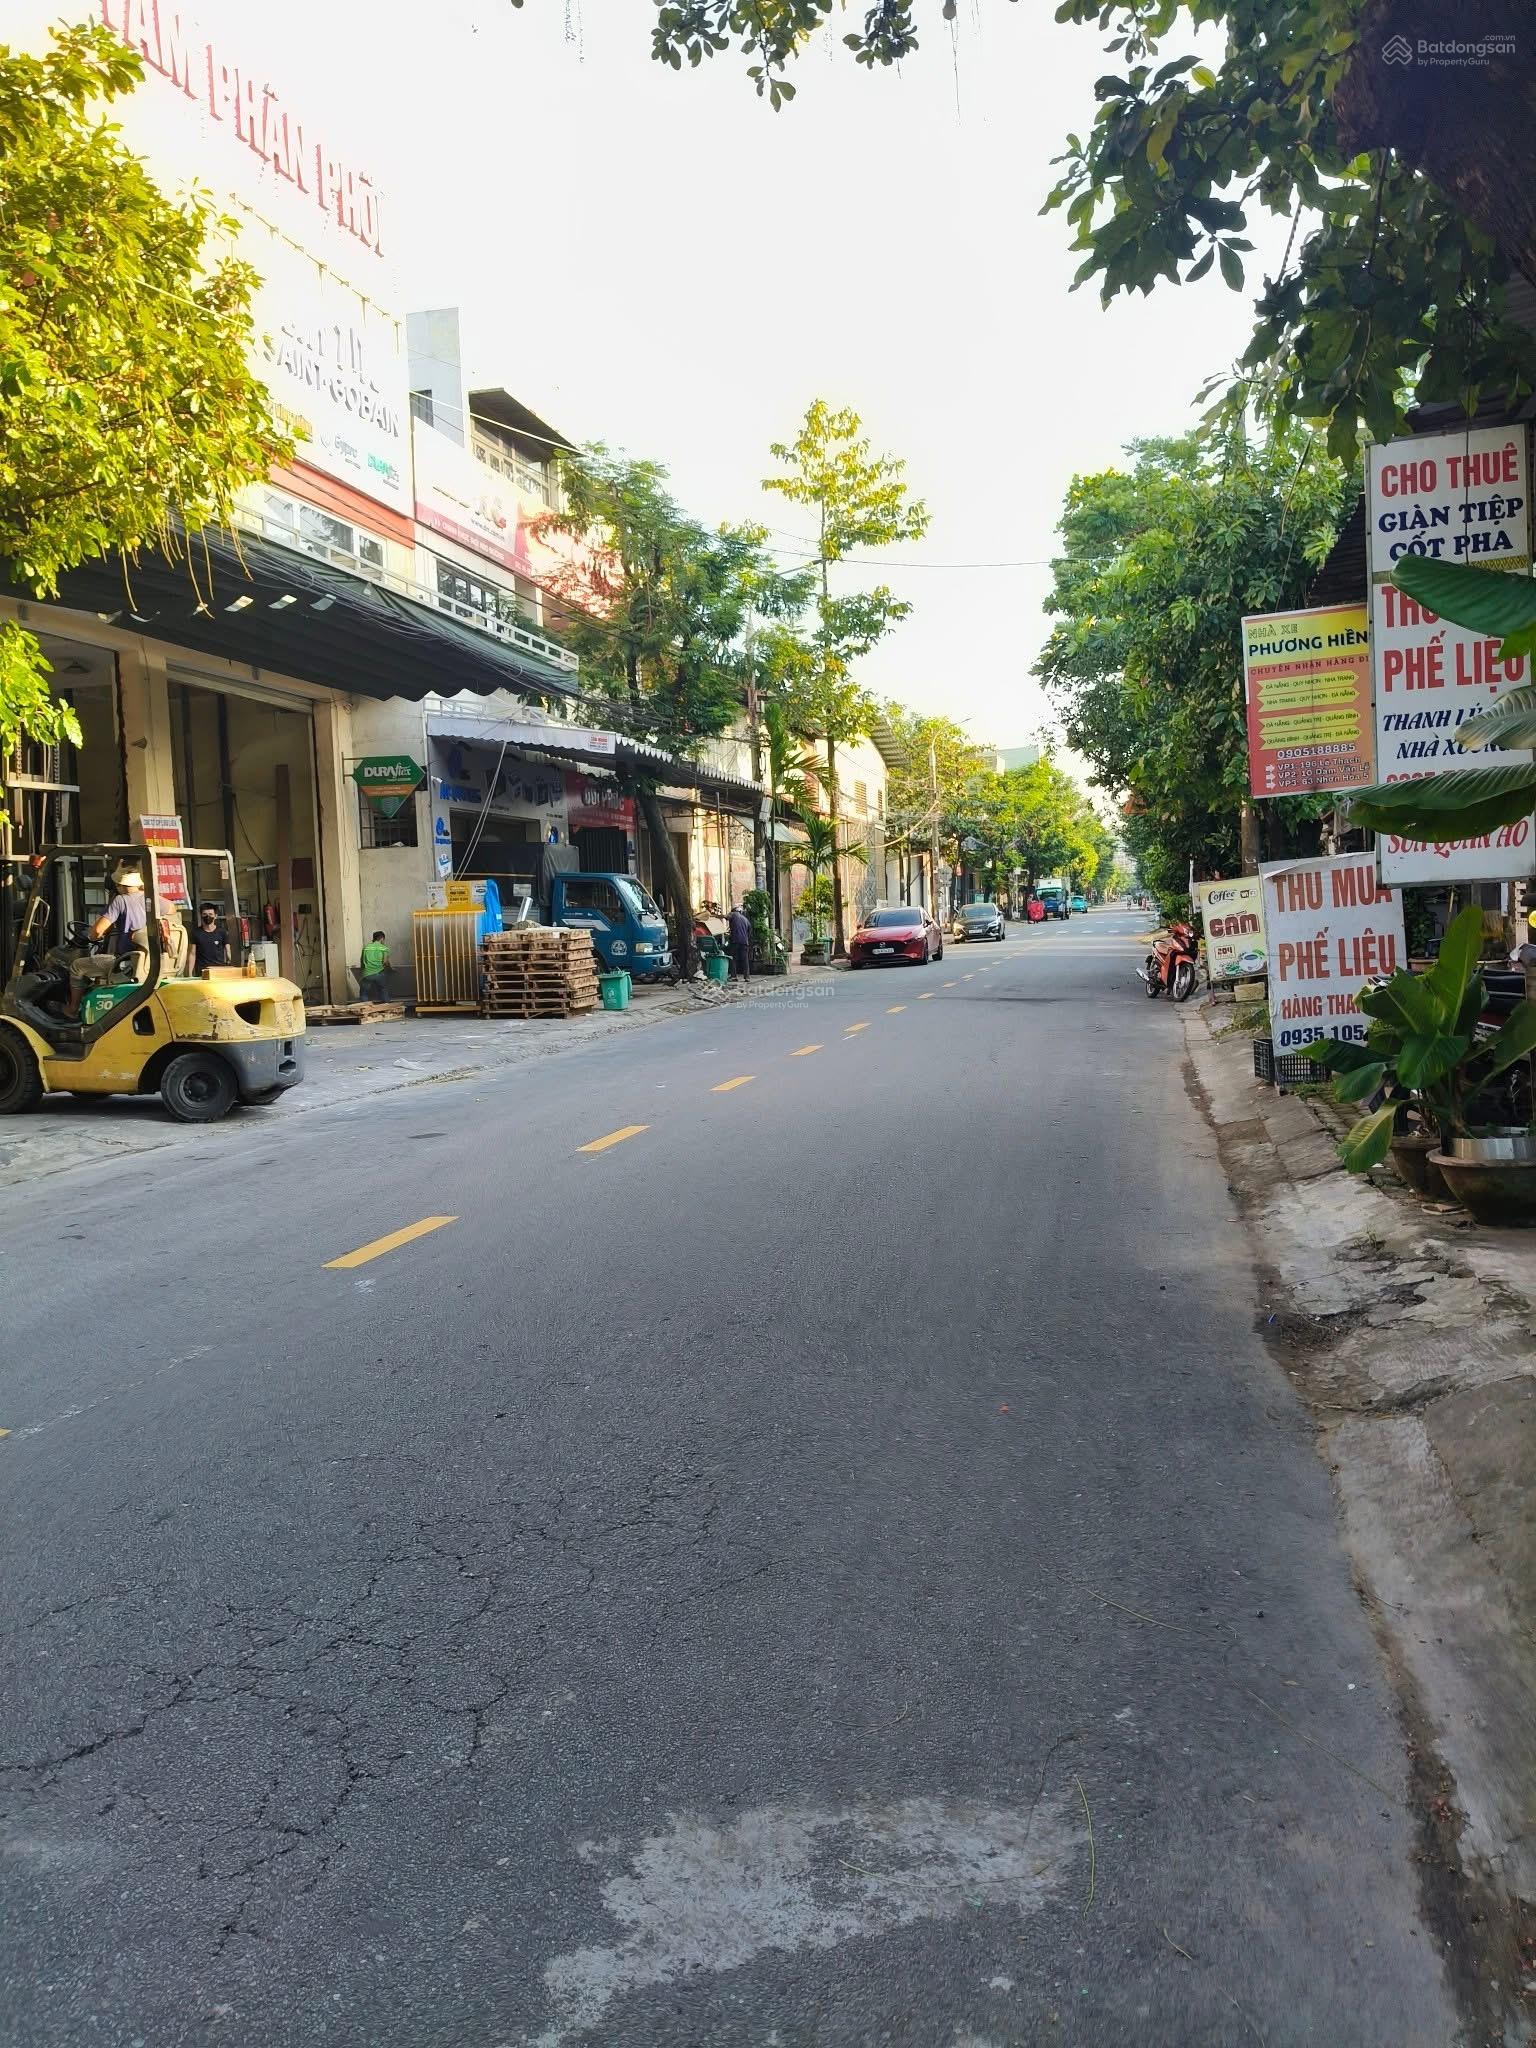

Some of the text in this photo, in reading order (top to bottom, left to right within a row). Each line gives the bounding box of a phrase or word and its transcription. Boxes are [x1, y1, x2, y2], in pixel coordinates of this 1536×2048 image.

[1381, 442, 1519, 497] CHO THUÊ
[1378, 494, 1524, 533] GIÀN TIỆP
[1389, 530, 1513, 562] CỐT PHA
[1248, 624, 1298, 639] NHÀ XE
[1248, 628, 1368, 656] PHƯƠNG HIỀN
[1384, 630, 1446, 692] PHẾ
[1383, 709, 1452, 732] THANH
[1396, 732, 1441, 760] NHÀ
[1208, 888, 1237, 905] Coffee
[1272, 871, 1324, 913] THU
[1278, 926, 1330, 981] PHẾ
[96, 1000, 114, 1010] 30
[1281, 993, 1323, 1020] HÀNG
[1280, 1026, 1325, 1047] 0935
